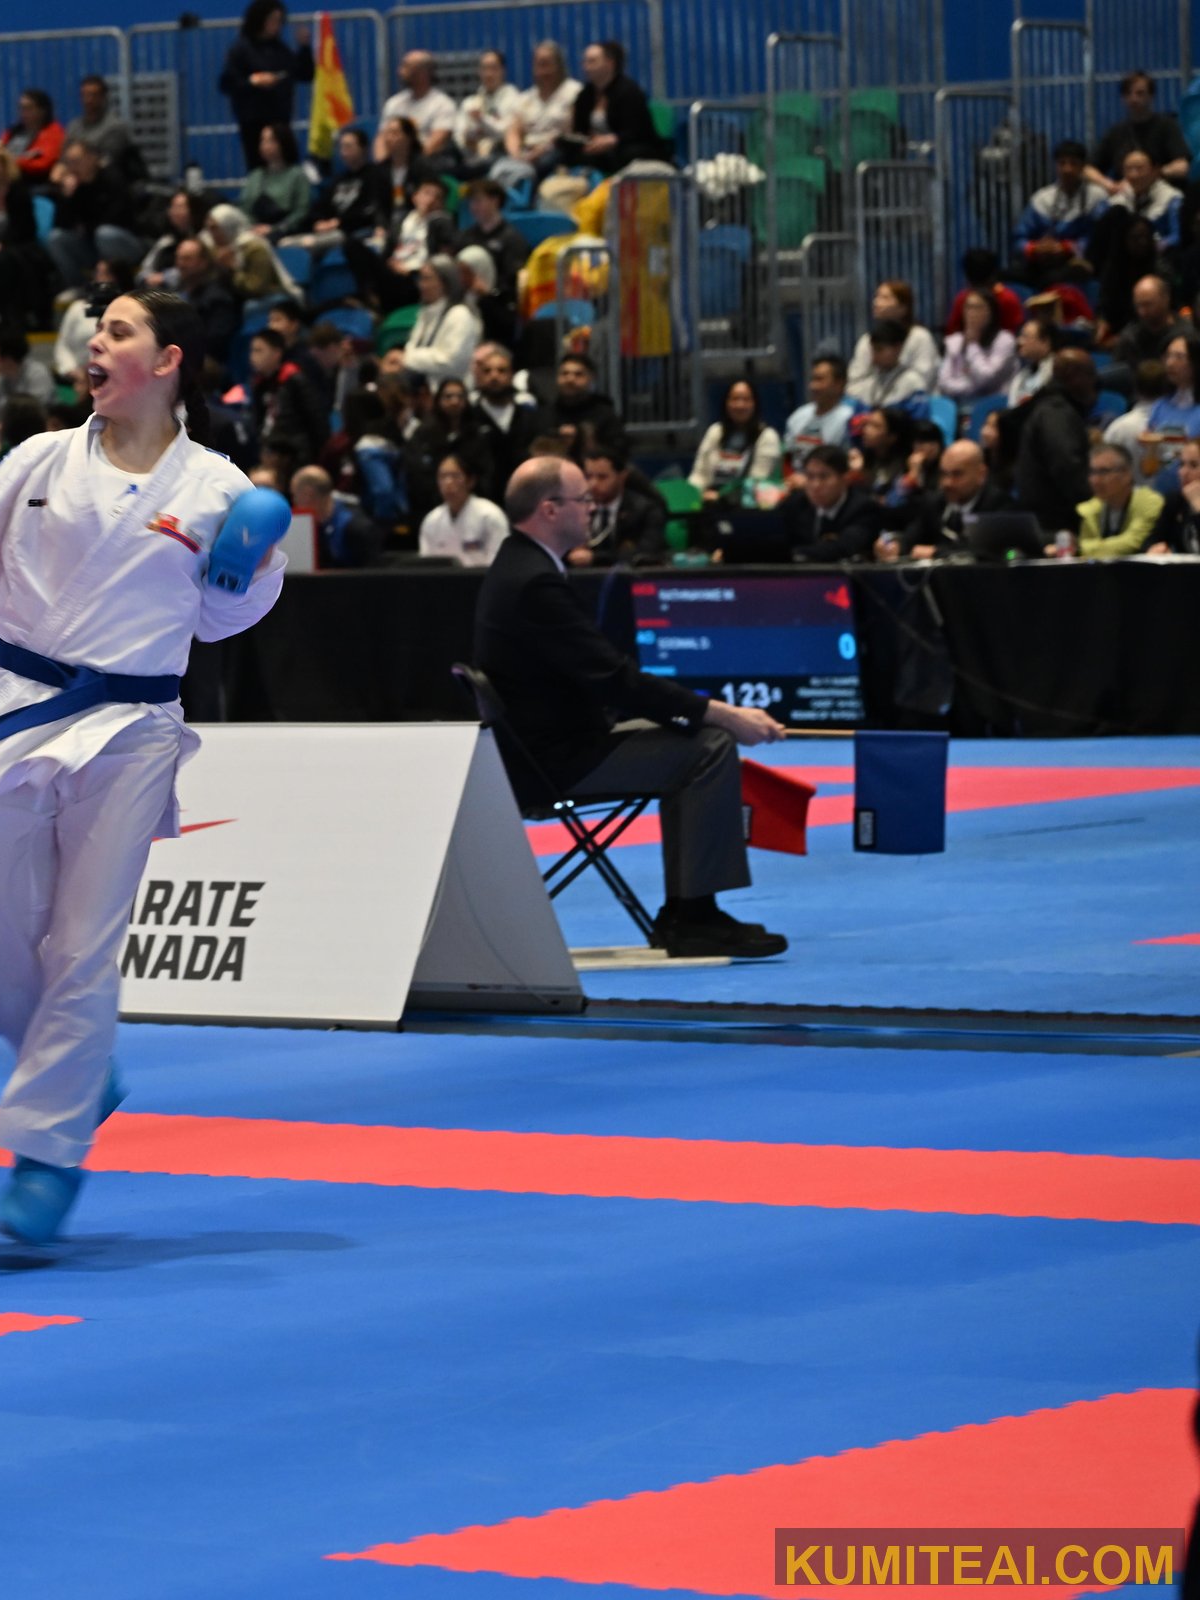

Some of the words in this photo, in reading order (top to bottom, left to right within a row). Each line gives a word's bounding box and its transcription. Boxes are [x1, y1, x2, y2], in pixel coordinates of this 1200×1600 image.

[839, 633, 856, 659] 0
[129, 880, 266, 927] RATE
[120, 934, 247, 981] NADA
